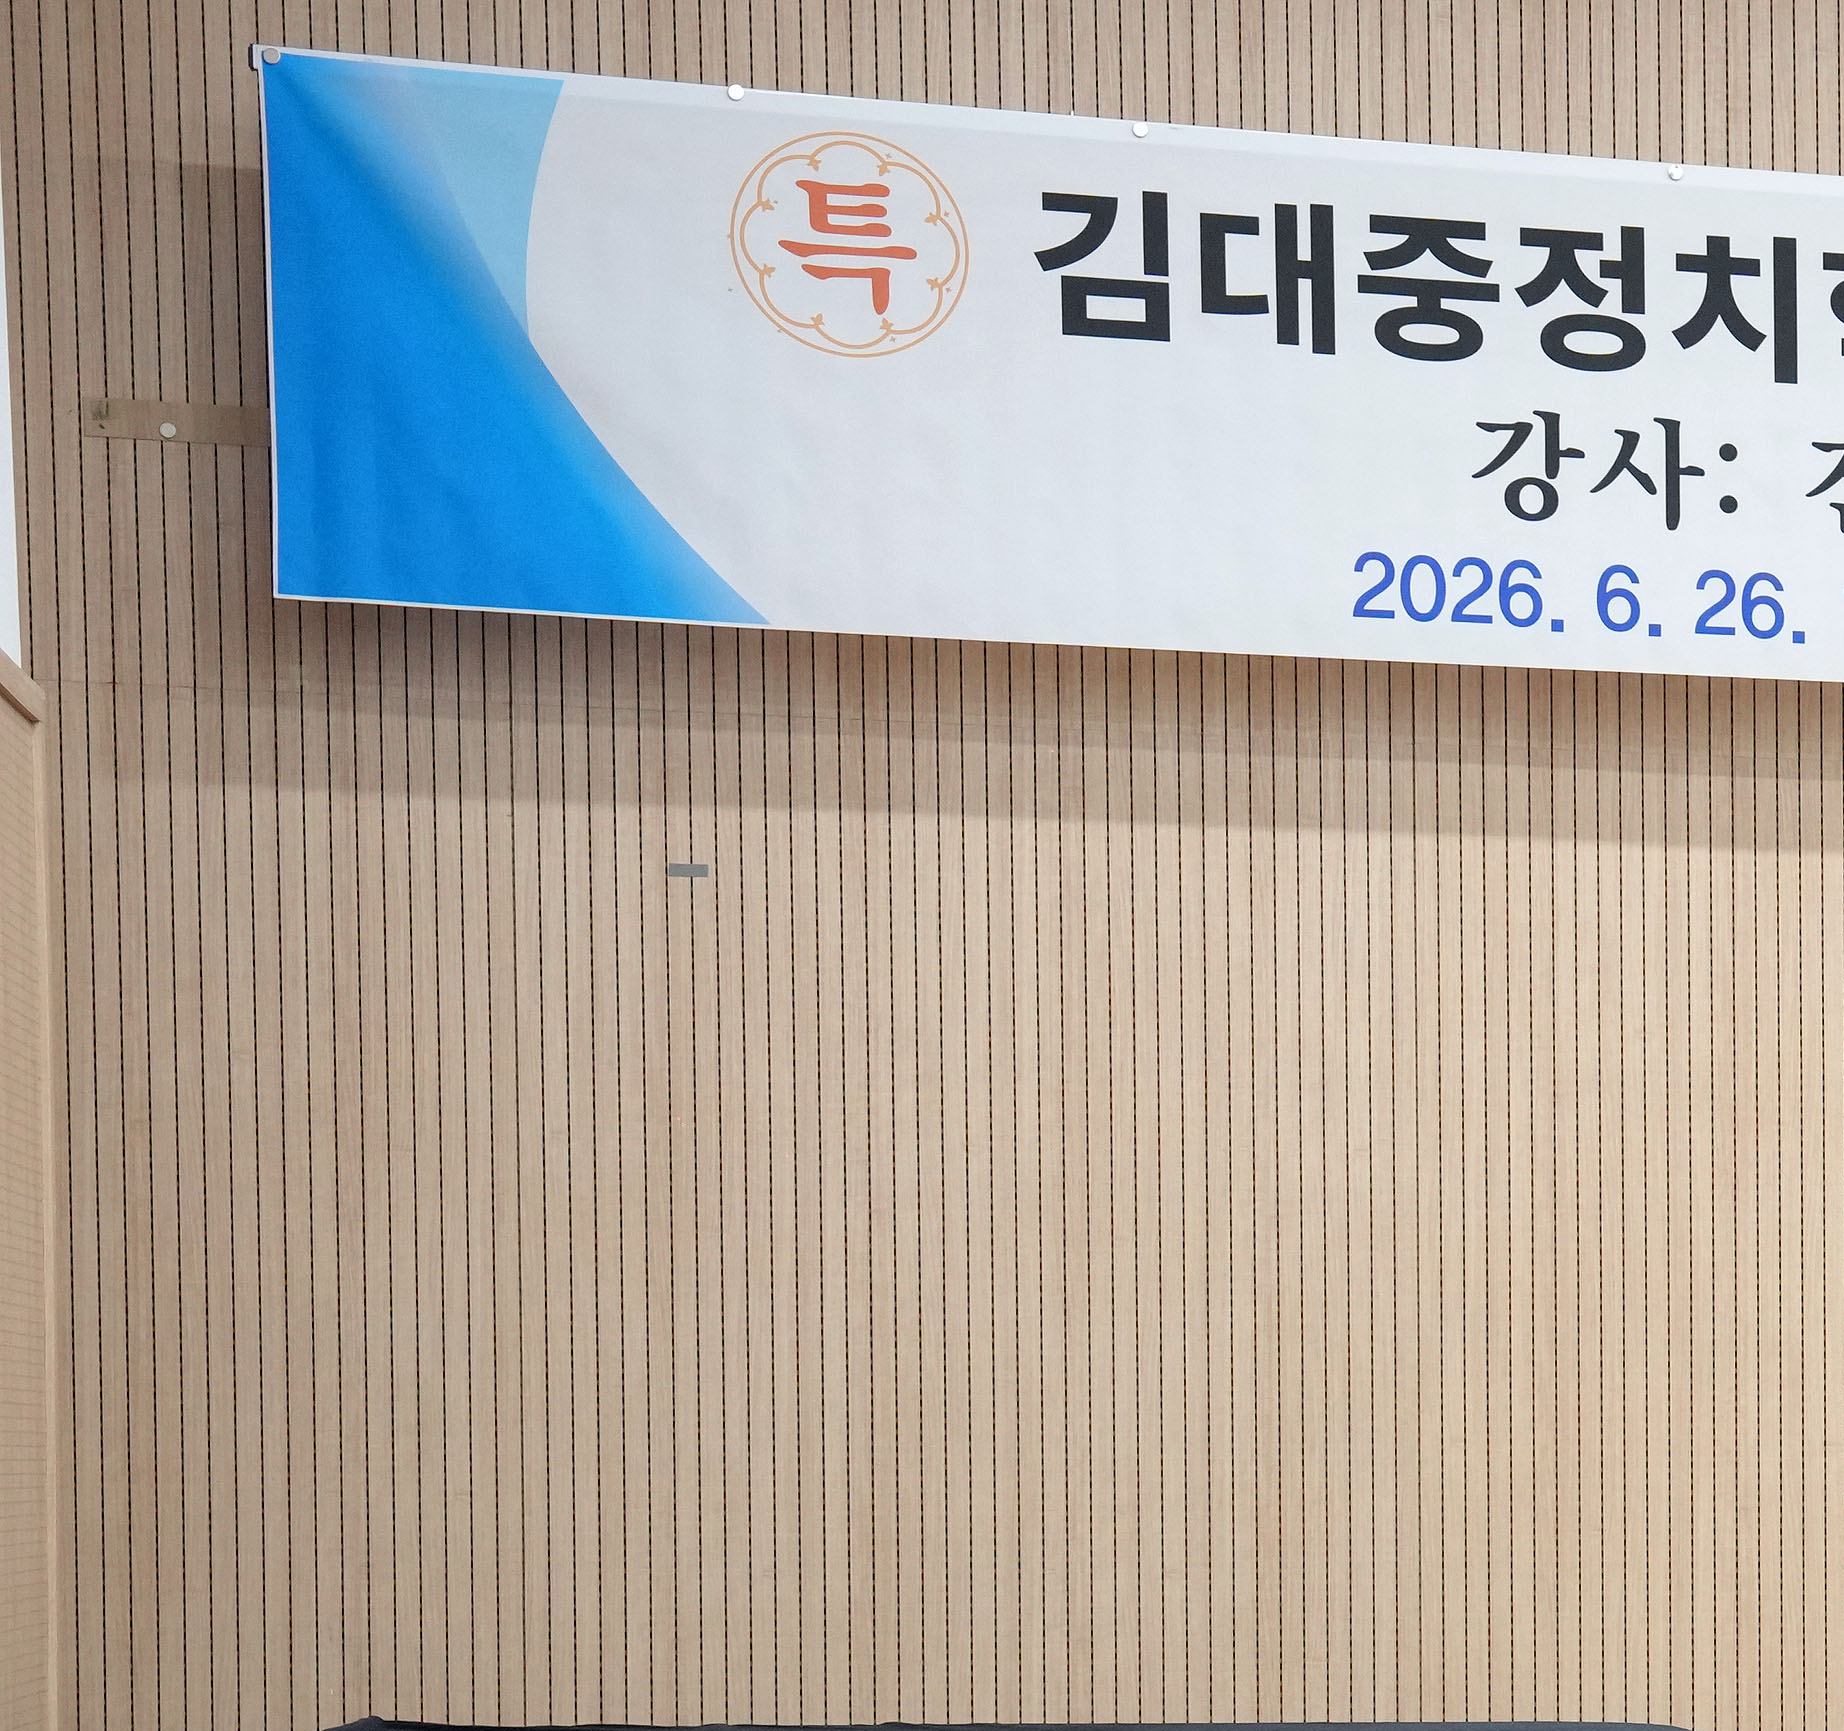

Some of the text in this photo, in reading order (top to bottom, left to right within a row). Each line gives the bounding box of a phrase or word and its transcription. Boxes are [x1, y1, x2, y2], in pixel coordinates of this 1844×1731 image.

[778, 178, 918, 317] 특
[1471, 410, 1739, 532] 강사:
[1352, 551, 1566, 634] 2026.
[1596, 564, 1662, 638] 6.
[1694, 569, 1806, 645] 26.
